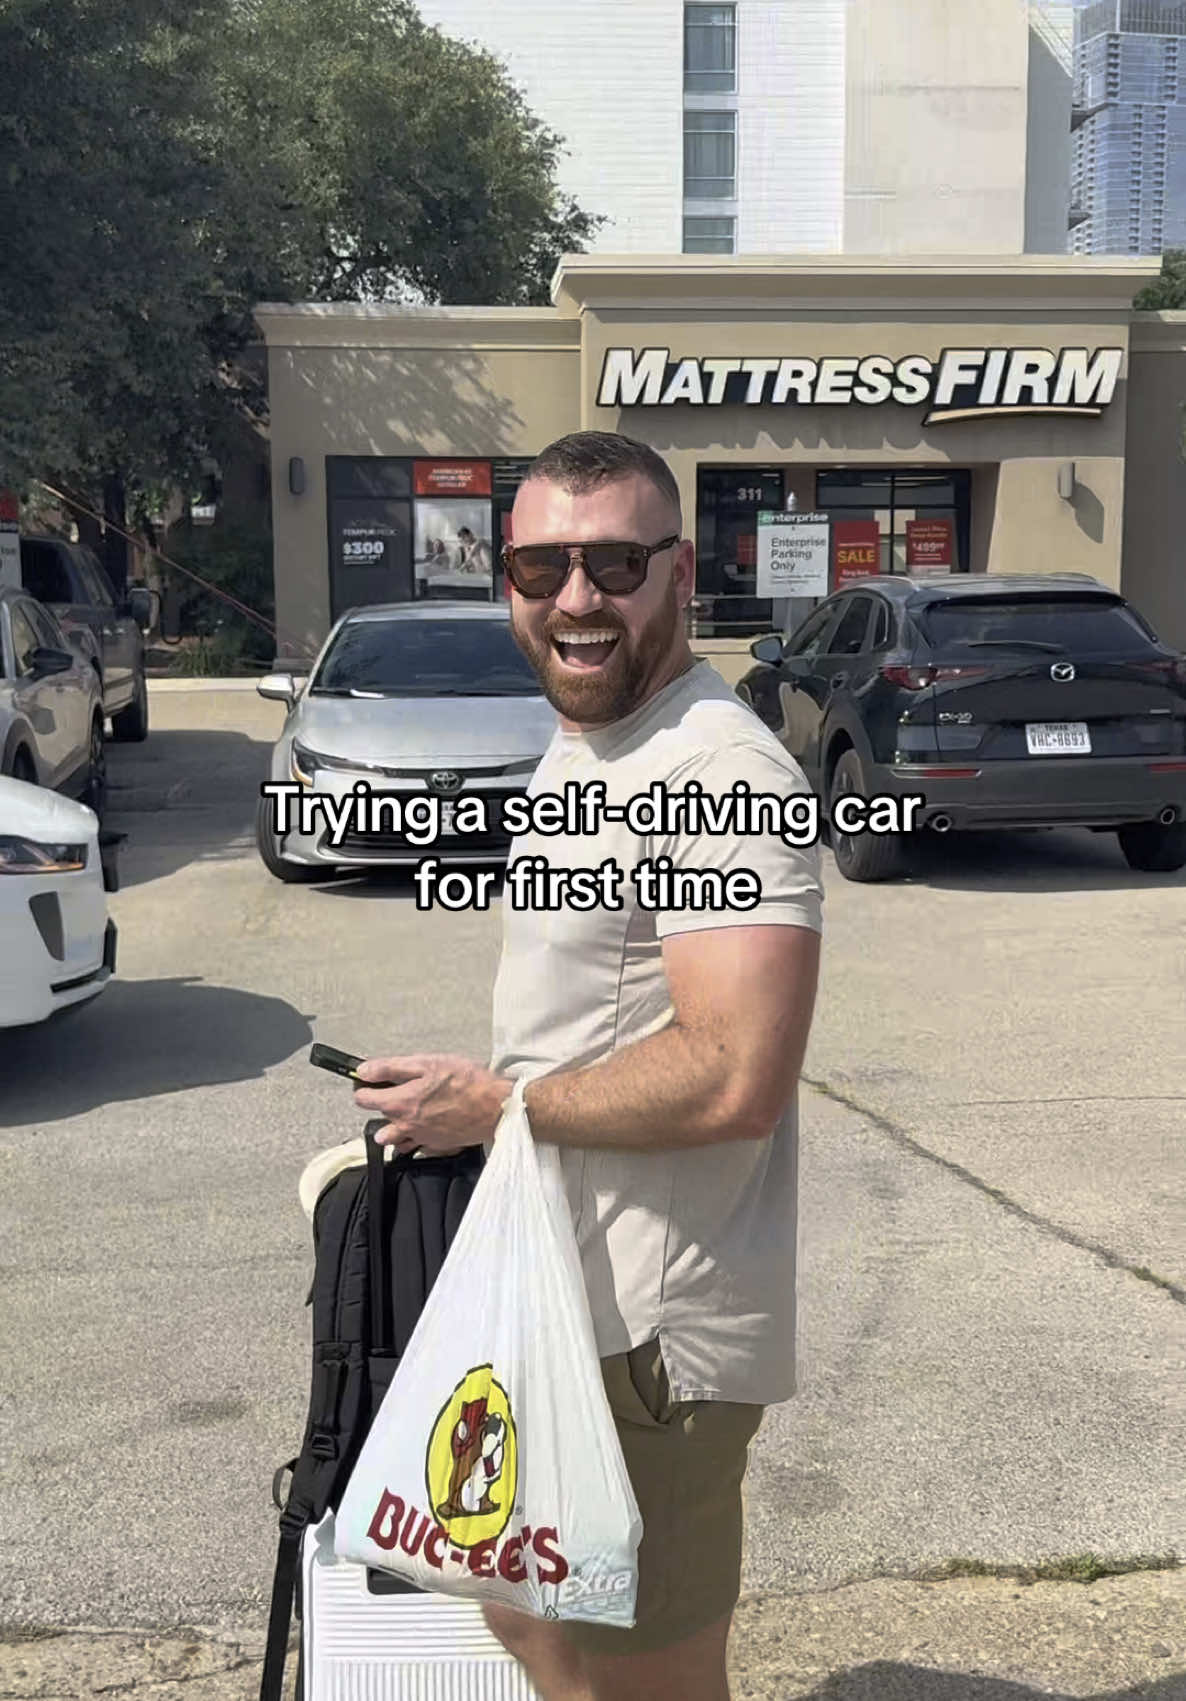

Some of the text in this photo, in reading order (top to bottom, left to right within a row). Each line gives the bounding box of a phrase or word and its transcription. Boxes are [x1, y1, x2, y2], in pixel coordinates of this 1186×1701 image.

[737, 488, 762, 500] 311
[344, 541, 384, 554] $300
[771, 538, 826, 548] Enterprise
[771, 549, 812, 560] Parking
[838, 550, 875, 563] SALE
[770, 561, 795, 571] Only
